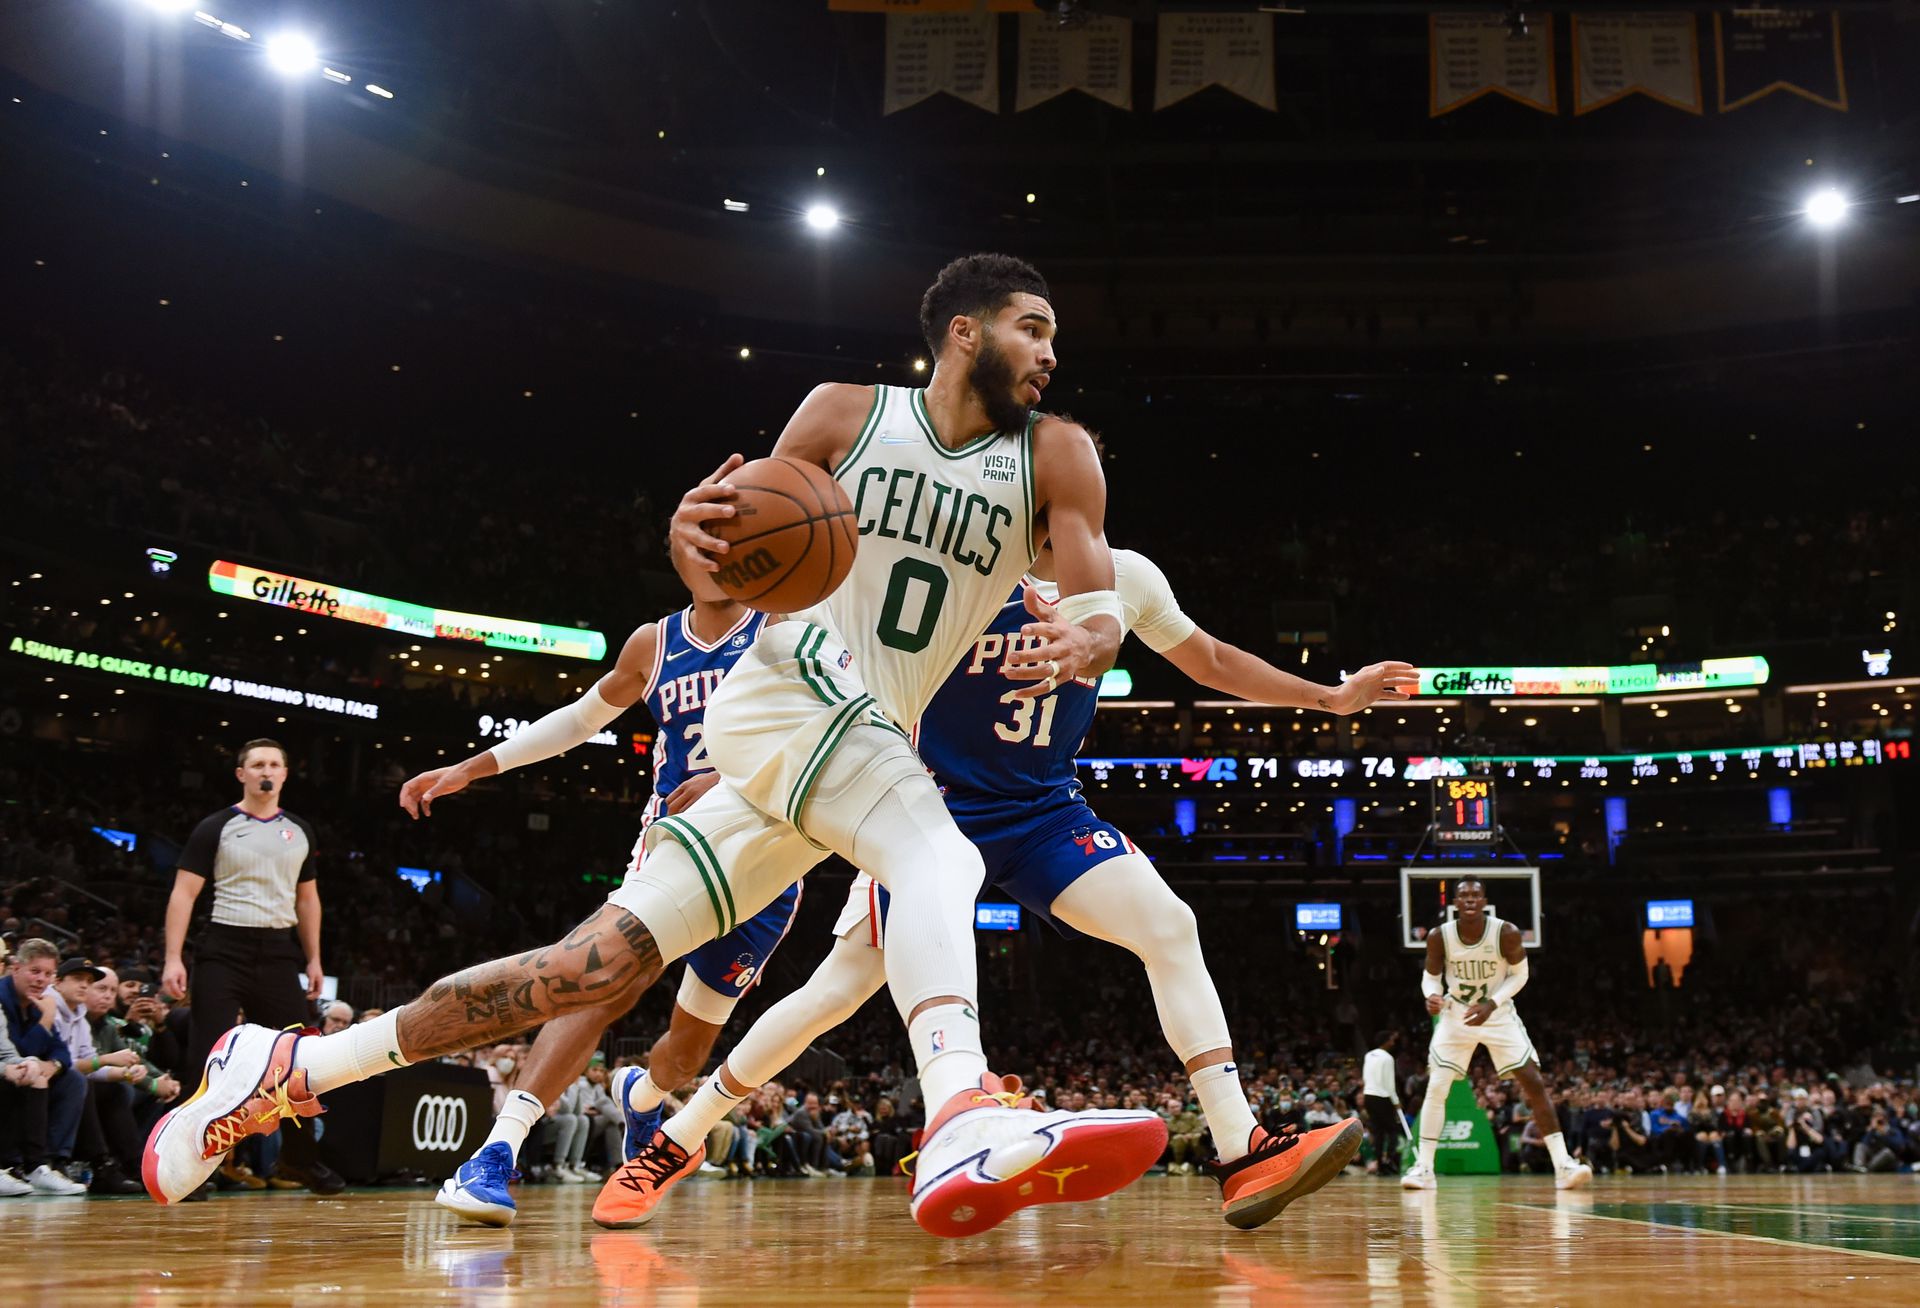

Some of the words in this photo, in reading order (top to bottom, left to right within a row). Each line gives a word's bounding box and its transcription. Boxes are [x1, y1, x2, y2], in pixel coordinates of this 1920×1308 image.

[984, 455, 1016, 471] VISTA
[983, 469, 1016, 483] PRINT
[854, 467, 1012, 576] CELTICS
[253, 576, 339, 613] Gillette
[876, 556, 949, 654] 0
[10, 637, 24, 652] A
[25, 640, 74, 664] SHAVE
[75, 652, 99, 668] AS
[100, 656, 152, 678] QUICK
[153, 666, 167, 681] &
[170, 668, 209, 688] EASY
[209, 676, 232, 693] AS
[233, 680, 304, 705] WASHING
[305, 693, 346, 713] YOUR
[345, 700, 379, 719] FACE
[1433, 671, 1513, 693] Gillette
[994, 689, 1058, 747] 31
[683, 723, 715, 771] 2
[1885, 741, 1909, 759] 11
[1248, 758, 1278, 778] 71
[1298, 760, 1344, 778] 6:54
[1362, 757, 1395, 778] 74
[1450, 781, 1487, 799] 6:54
[1456, 799, 1484, 825] 11
[1073, 831, 1117, 856] 76
[1450, 959, 1498, 981] CELTICS
